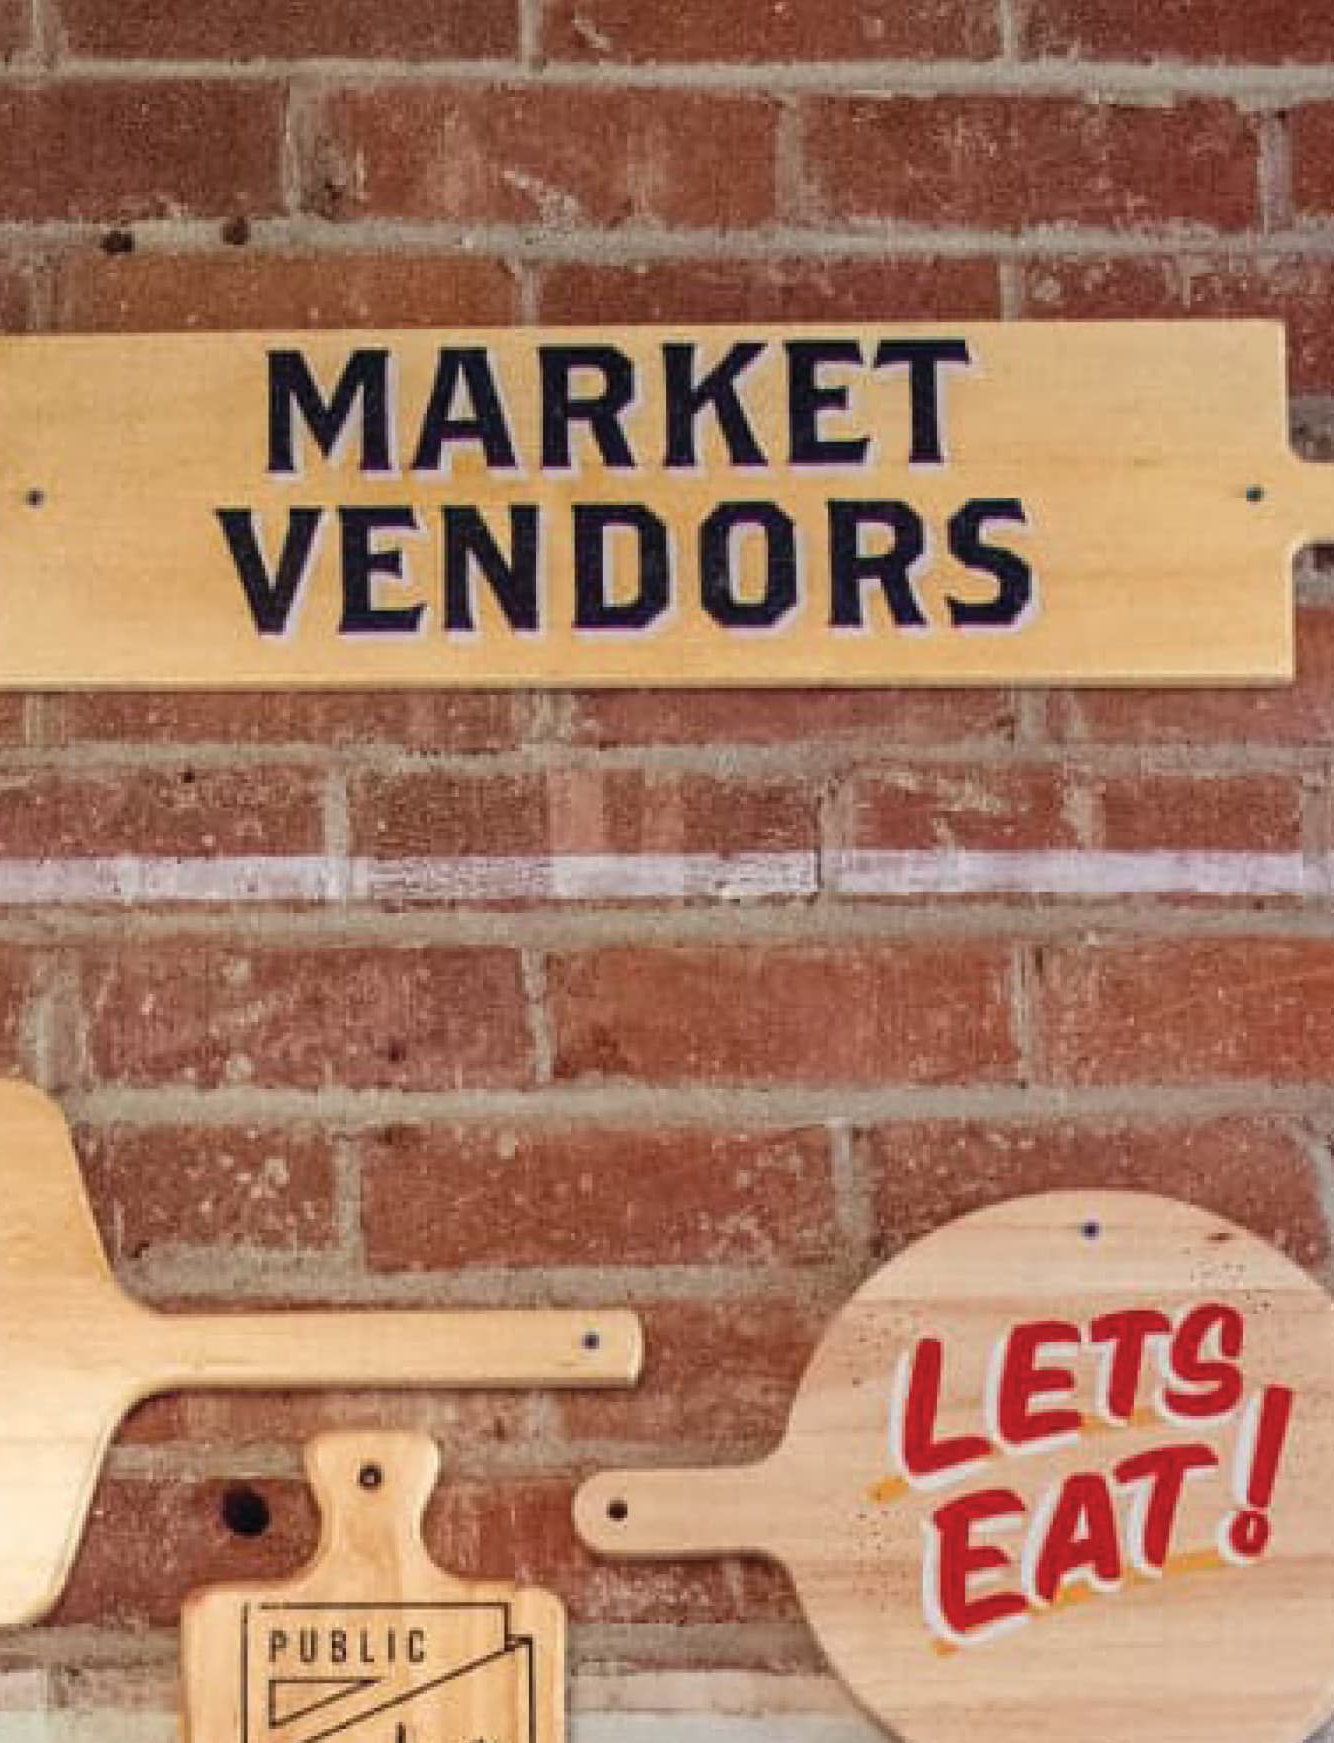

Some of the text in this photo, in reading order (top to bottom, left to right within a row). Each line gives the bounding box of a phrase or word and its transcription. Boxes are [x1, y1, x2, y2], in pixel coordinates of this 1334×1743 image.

[265, 339, 975, 478] MARKET
[215, 498, 1037, 640] VENDORS
[887, 1302, 1247, 1490] LETS
[921, 1384, 1295, 1642] EAT!
[268, 1629, 428, 1664] PUBLIC
